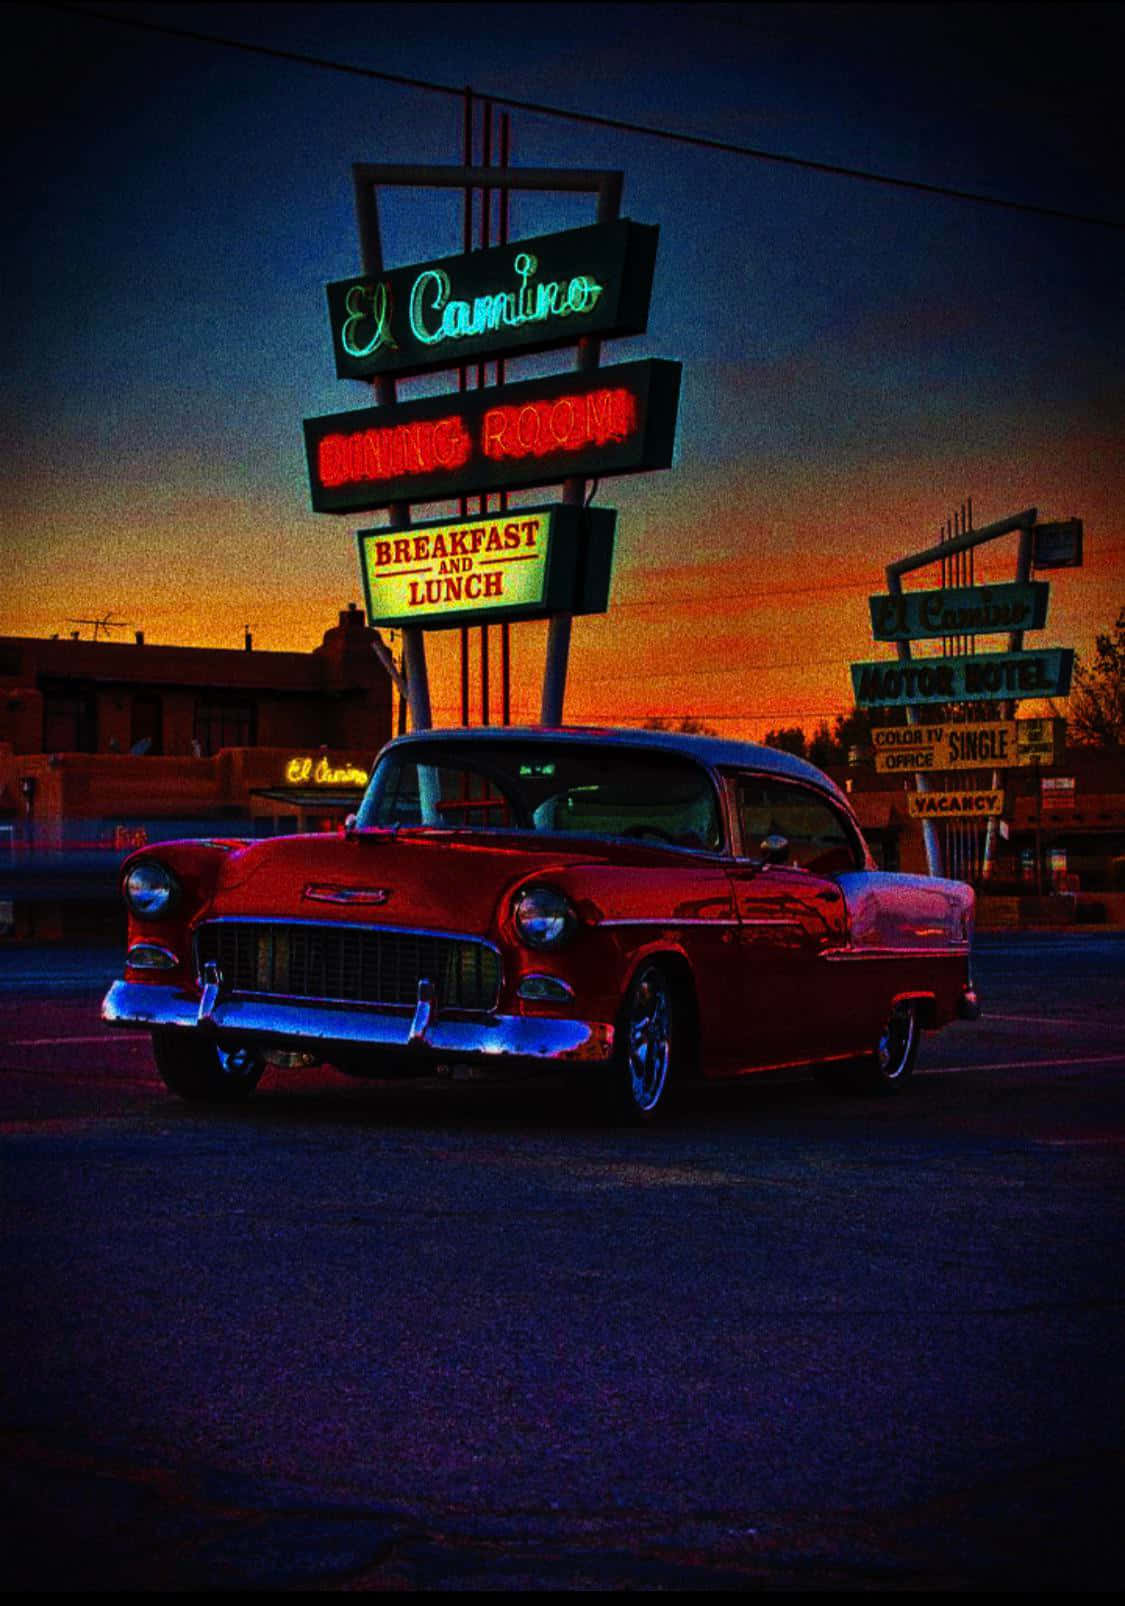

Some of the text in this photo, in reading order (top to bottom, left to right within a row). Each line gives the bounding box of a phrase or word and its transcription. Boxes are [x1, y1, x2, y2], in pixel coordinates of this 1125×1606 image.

[342, 252, 603, 357] El Camino
[318, 388, 635, 487] DINING ROOM
[375, 520, 539, 566] BREAKFAST
[438, 557, 474, 575] AND
[409, 572, 503, 606] LUNCH
[858, 658, 1056, 700] MOTOR HOTEL
[876, 728, 943, 746] COLOR TV
[949, 728, 1008, 762] SINGLE
[286, 756, 312, 783] El
[886, 752, 933, 769] OFFICE
[914, 795, 998, 811] VACANCY
